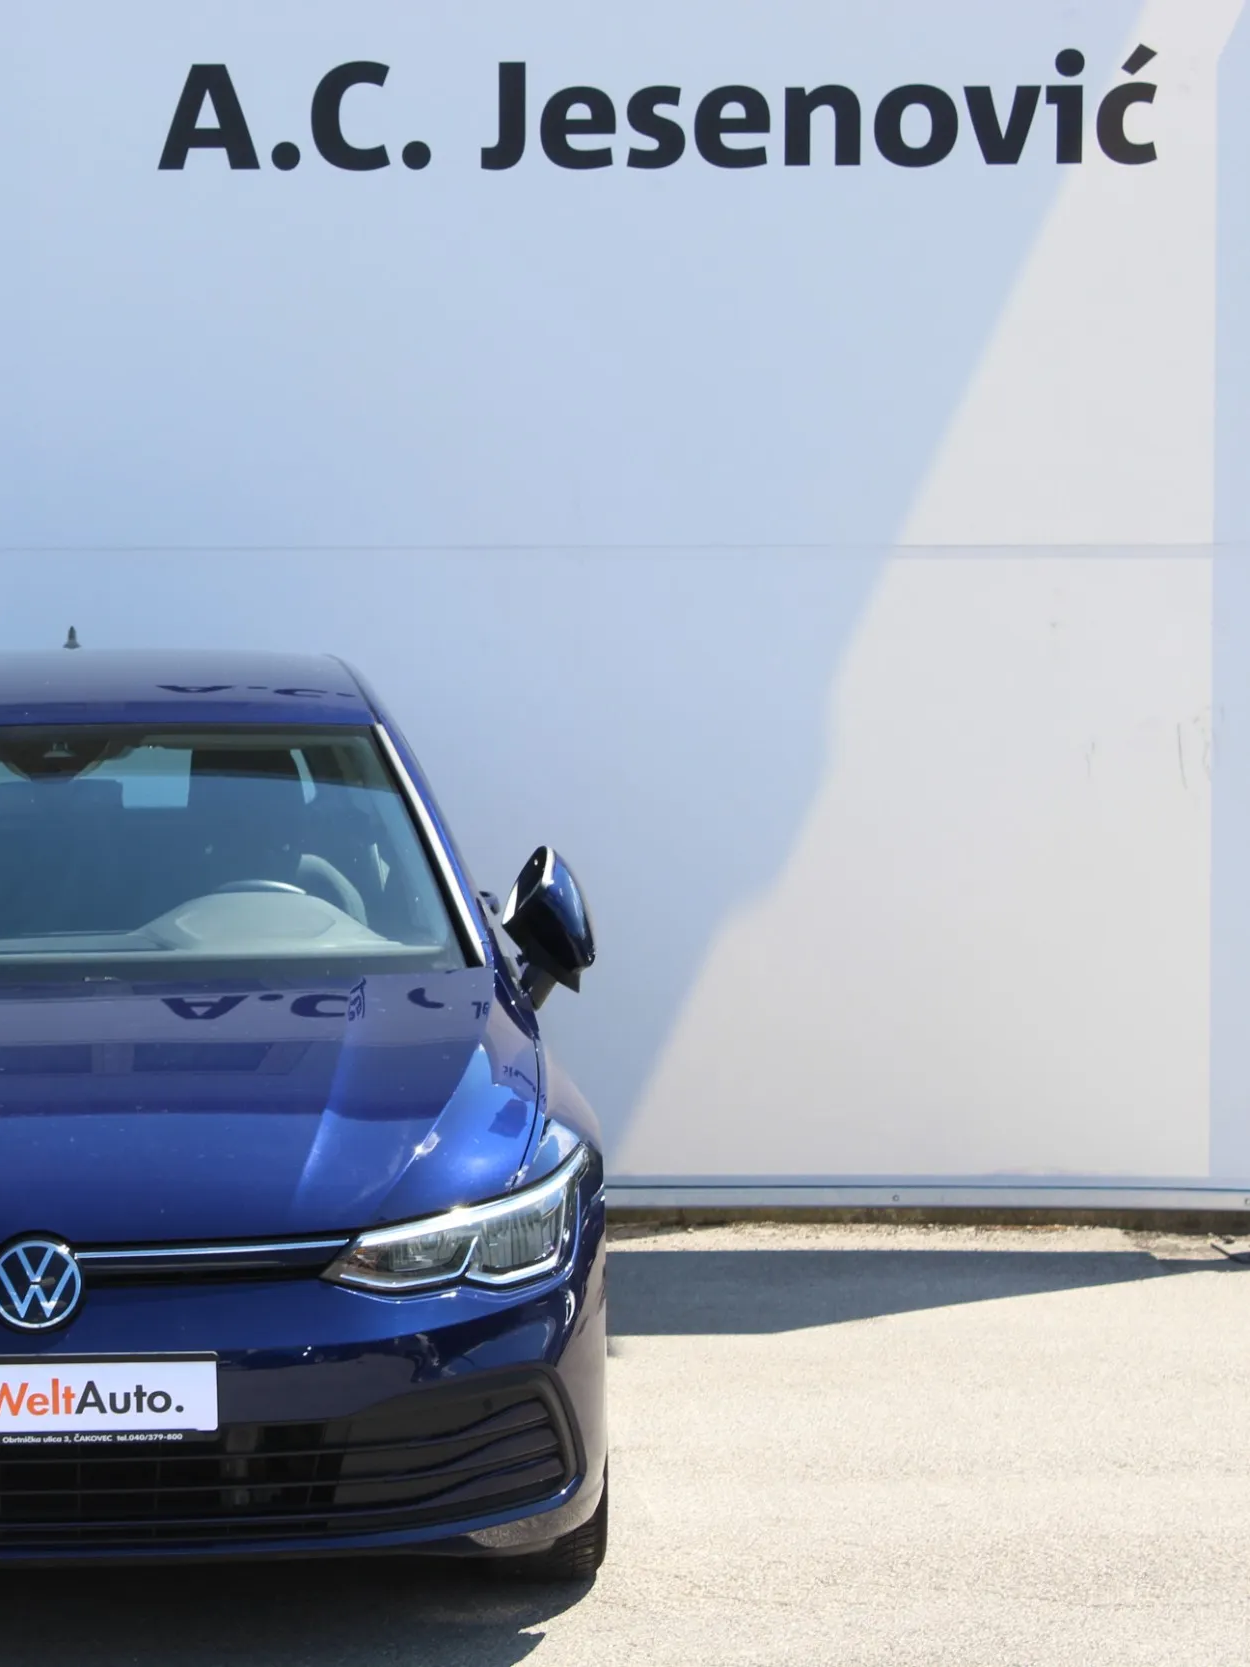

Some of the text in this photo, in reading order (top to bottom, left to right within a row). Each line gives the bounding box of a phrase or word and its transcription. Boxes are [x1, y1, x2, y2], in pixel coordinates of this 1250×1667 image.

[157, 43, 1158, 172] A.C. Jesenović
[73, 1433, 113, 1443] ČAKOVEC
